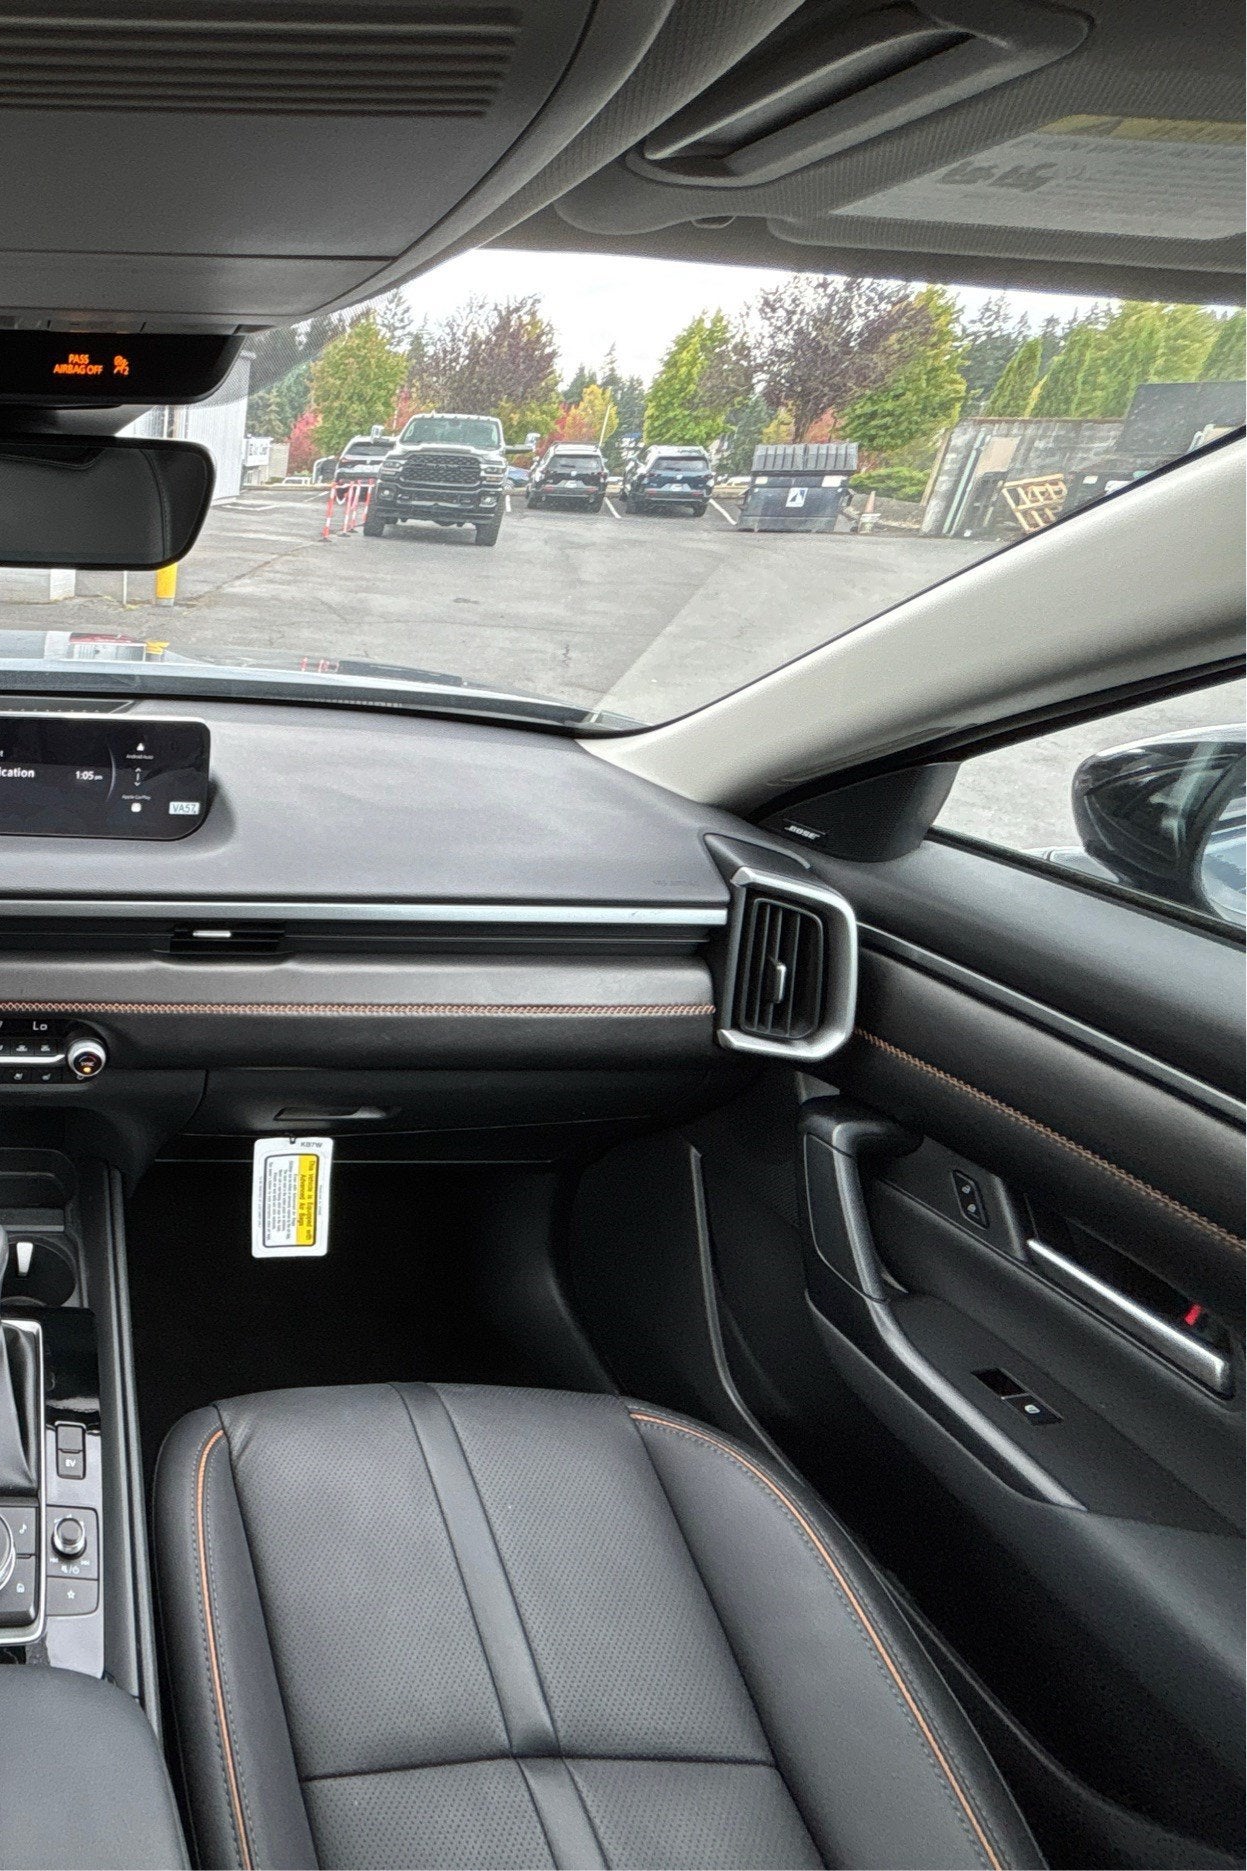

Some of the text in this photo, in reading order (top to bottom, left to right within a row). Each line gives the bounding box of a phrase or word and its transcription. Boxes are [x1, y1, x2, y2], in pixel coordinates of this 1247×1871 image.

[68, 354, 89, 364] PASS
[53, 363, 103, 375] AIRBAG OFF
[75, 770, 94, 780] 1:05
